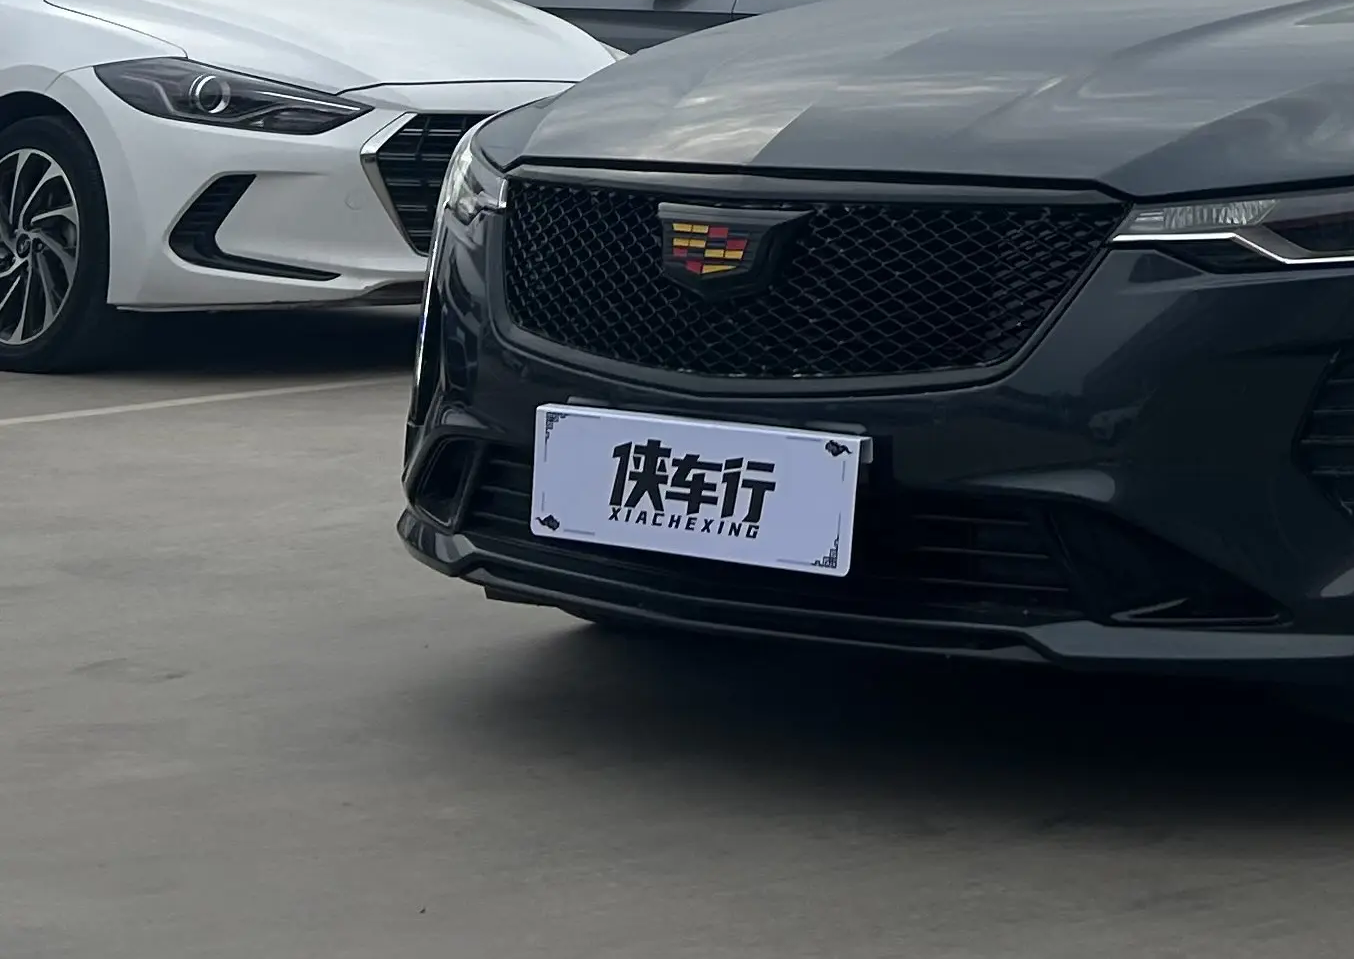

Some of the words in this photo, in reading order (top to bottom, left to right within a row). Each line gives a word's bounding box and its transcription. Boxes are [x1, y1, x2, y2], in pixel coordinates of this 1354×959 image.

[609, 439, 776, 523] 侠车行
[608, 507, 760, 539] XIACHEXING
